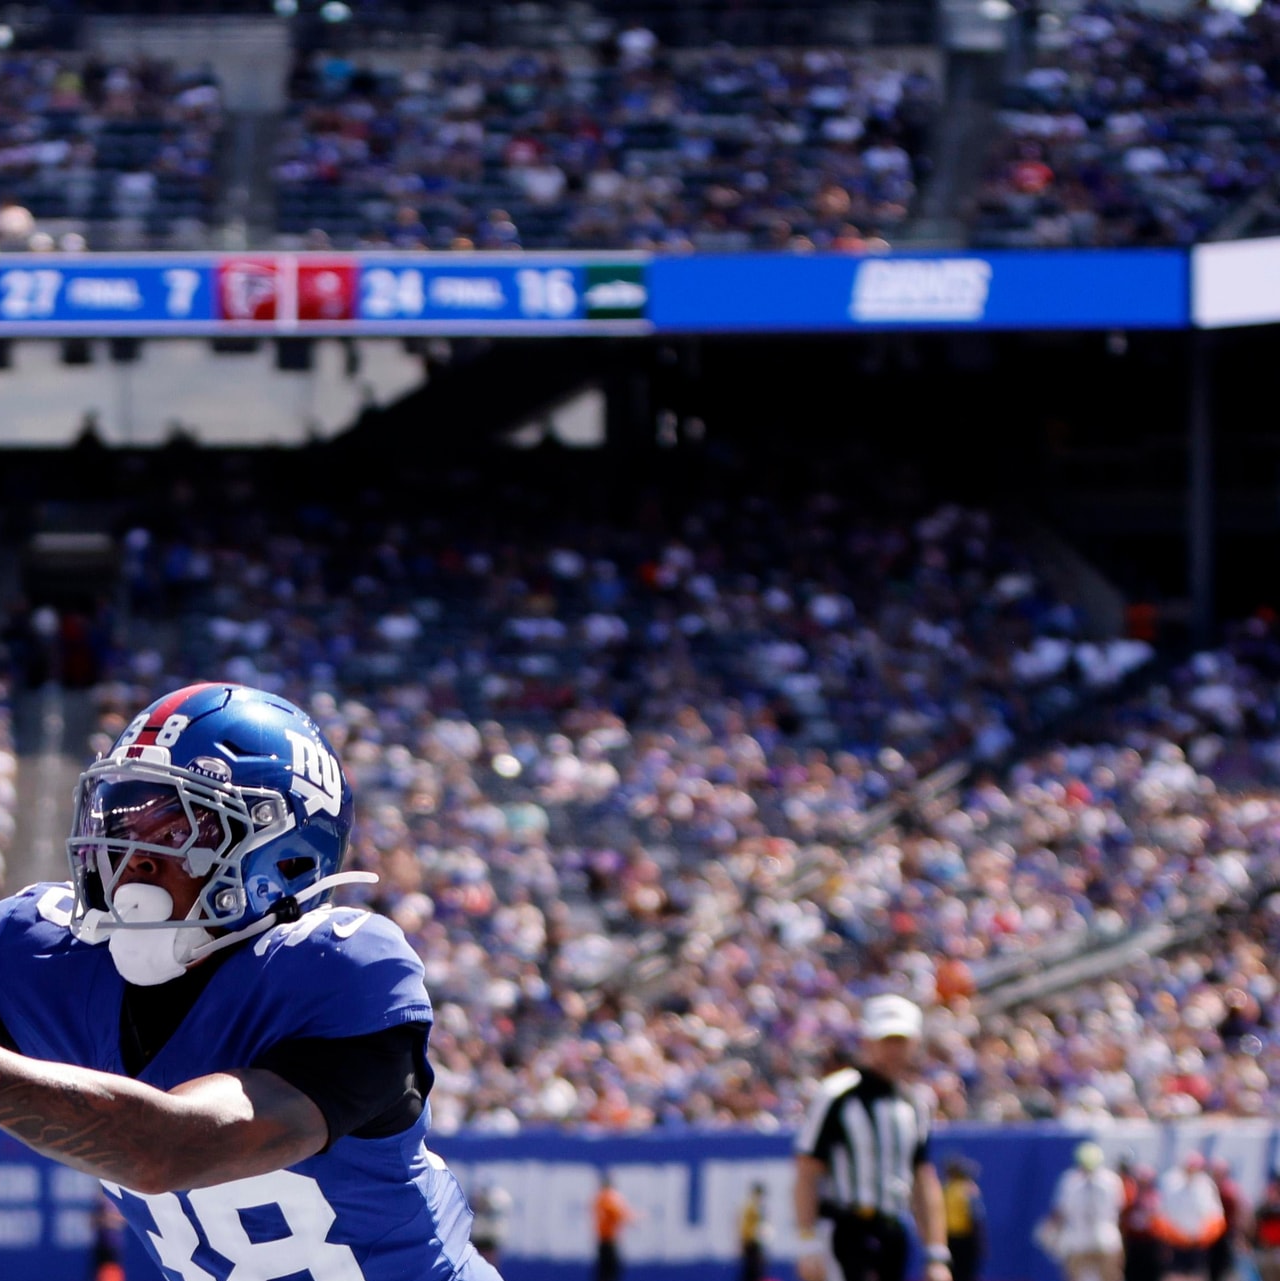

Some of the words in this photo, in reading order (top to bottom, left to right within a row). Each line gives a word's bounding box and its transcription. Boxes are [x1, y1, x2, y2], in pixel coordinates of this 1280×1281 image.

[163, 269, 199, 317] 7
[361, 269, 424, 317] 24
[517, 269, 577, 317] 16
[121, 713, 190, 748] 38
[188, 765, 229, 782] OAKLEY
